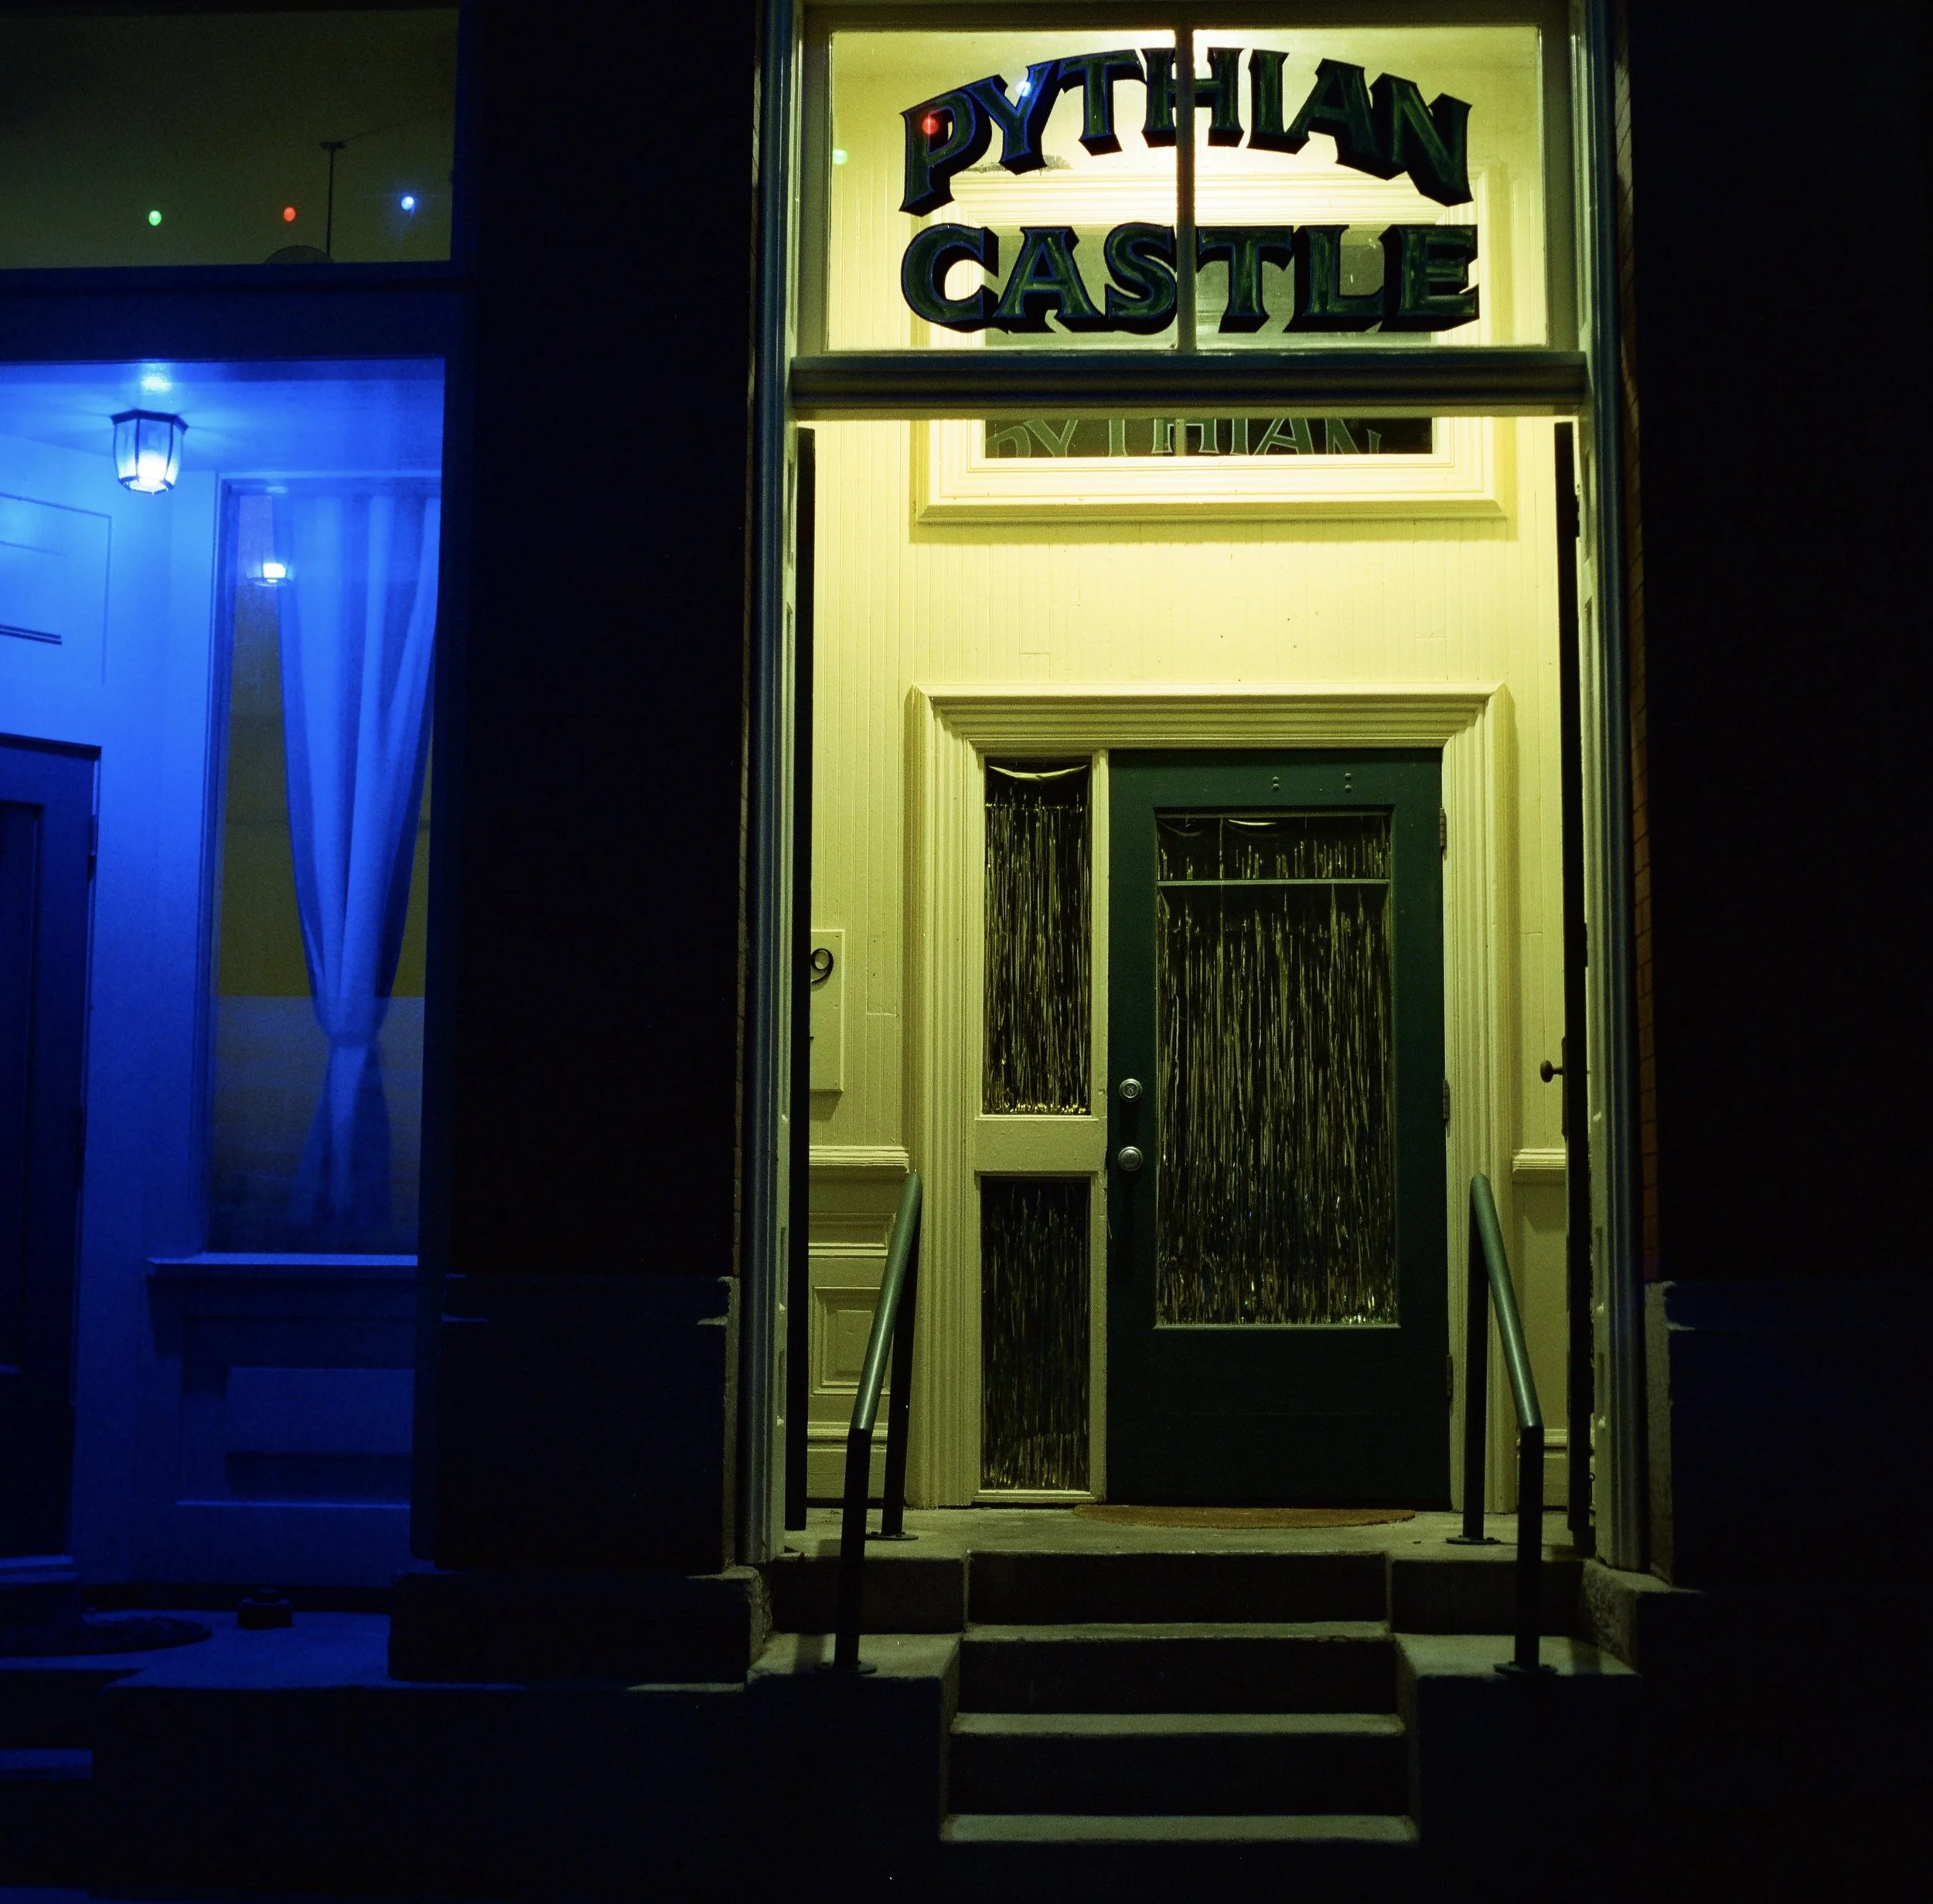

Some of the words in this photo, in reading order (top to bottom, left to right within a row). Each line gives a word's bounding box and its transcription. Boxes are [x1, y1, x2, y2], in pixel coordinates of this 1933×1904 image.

[900, 48, 1473, 216] PYTHIAN
[902, 222, 1480, 333] CASTLE
[811, 948, 834, 983] 9
